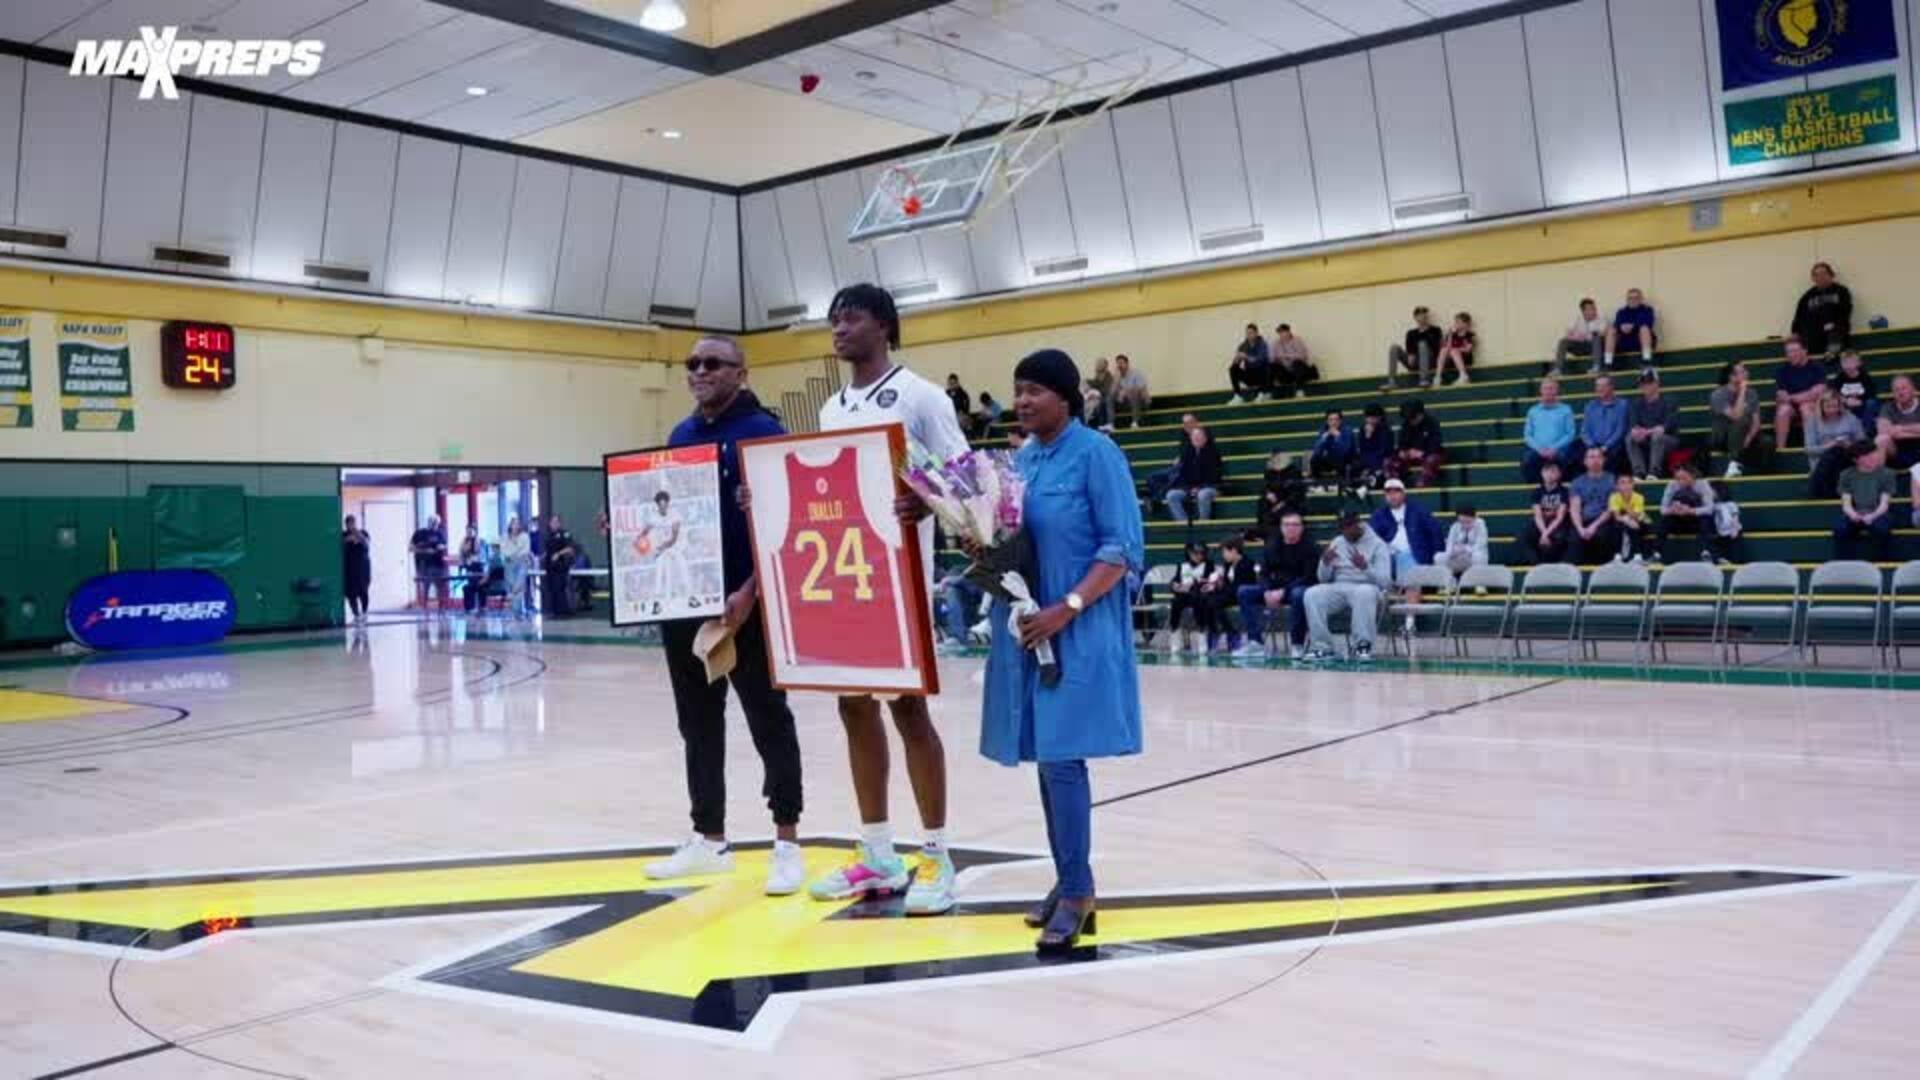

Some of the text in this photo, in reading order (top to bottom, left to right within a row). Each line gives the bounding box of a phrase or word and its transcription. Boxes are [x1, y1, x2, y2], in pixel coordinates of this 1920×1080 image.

[1781, 106, 1894, 139] BASKETBALL
[1764, 129, 1864, 158] CHAMPIONS
[185, 354, 219, 384] 24
[794, 527, 874, 600] 24
[100, 601, 227, 618] TANAGER
